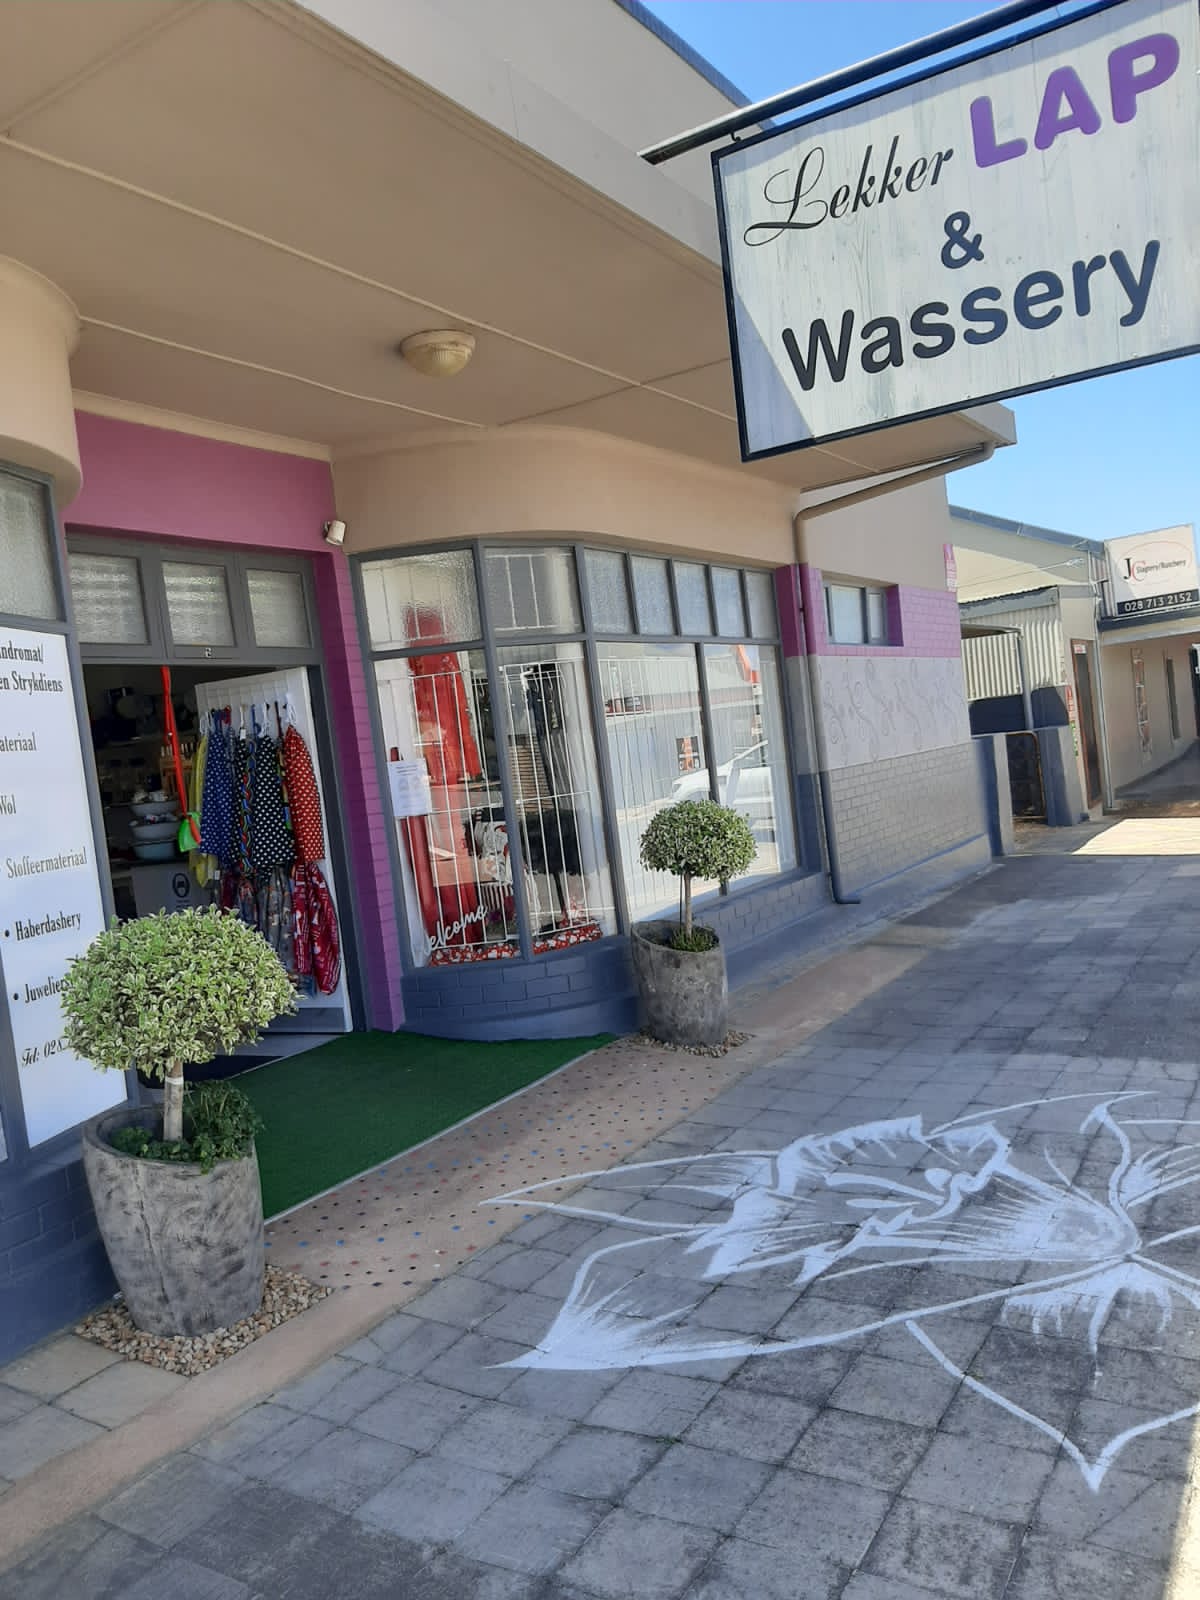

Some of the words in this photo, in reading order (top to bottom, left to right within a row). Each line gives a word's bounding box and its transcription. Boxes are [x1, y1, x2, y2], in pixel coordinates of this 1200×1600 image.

[743, 135, 953, 246] Lekker
[970, 33, 1180, 168] LAP
[940, 211, 984, 269] &
[782, 240, 1160, 391] Wassery
[1124, 600, 1144, 612] 028
[1146, 597, 1165, 608] 713
[1167, 591, 1193, 604] 2152
[11, 670, 63, 696] Strykdiens
[15, 910, 81, 941] Haberdashery
